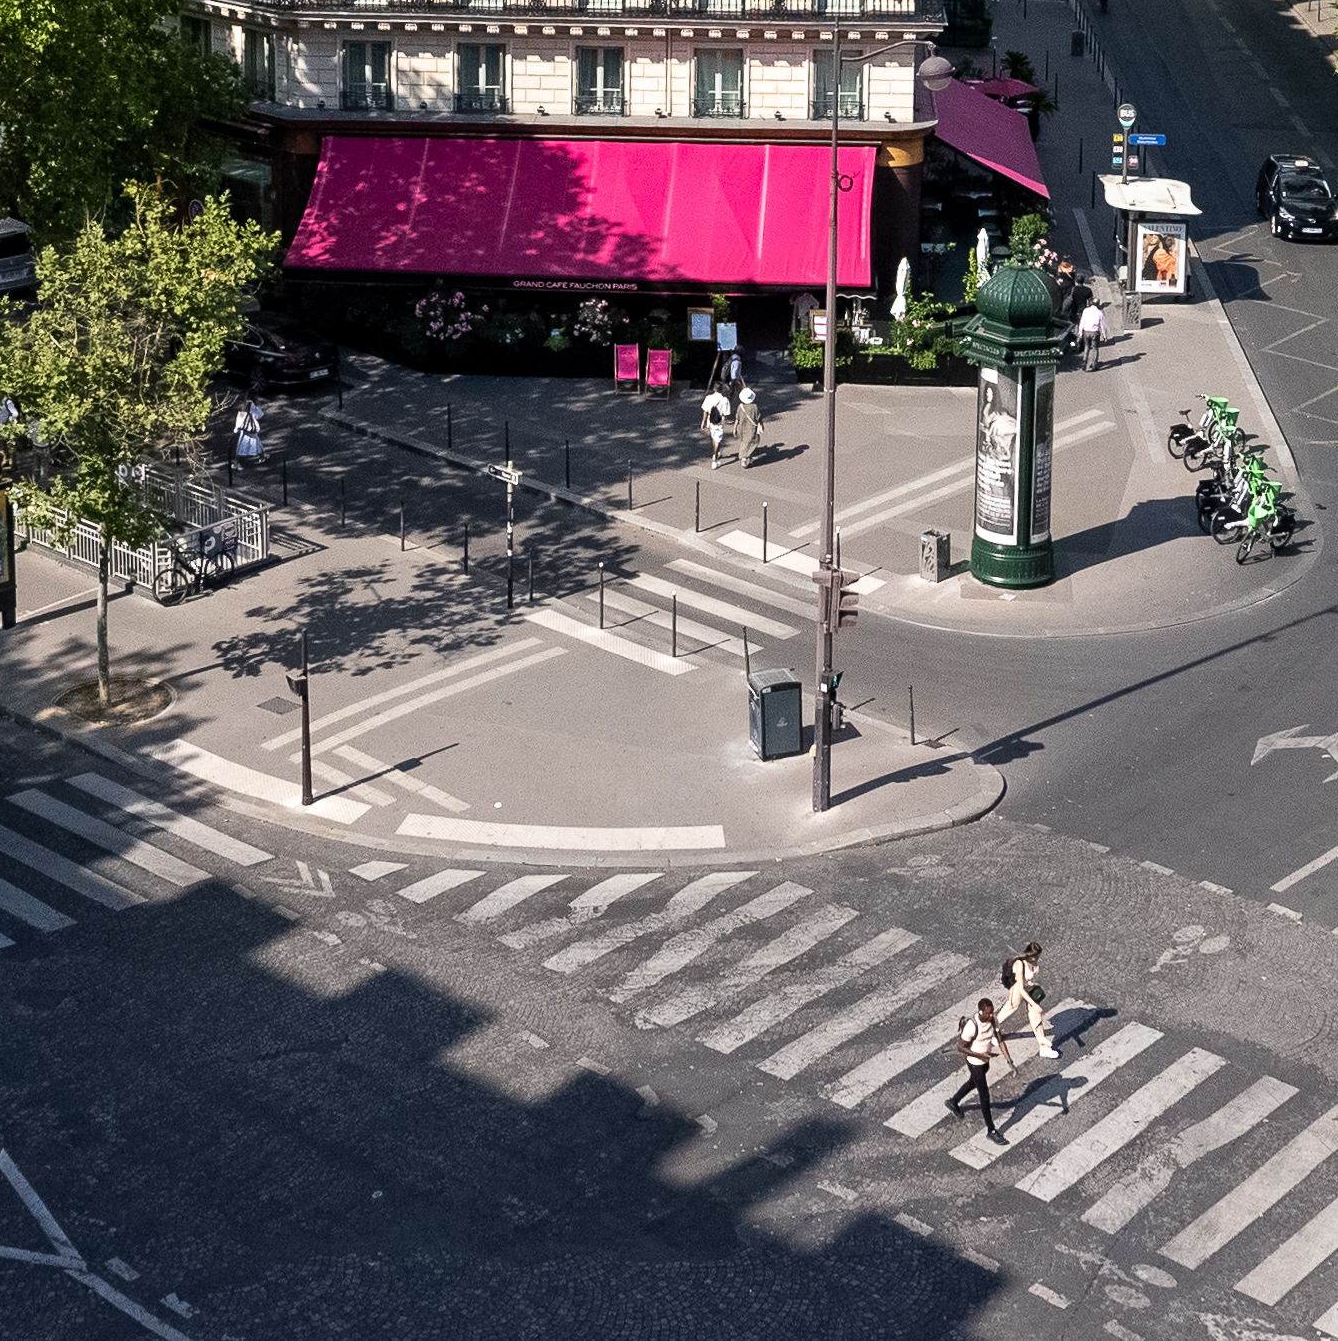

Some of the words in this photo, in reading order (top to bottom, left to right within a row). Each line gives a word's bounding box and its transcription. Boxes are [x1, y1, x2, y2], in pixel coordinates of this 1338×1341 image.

[1120, 109, 1135, 118] BUS
[1143, 225, 1182, 233] VALENTINO
[570, 282, 611, 290] FAUCHON
[1013, 349, 1050, 357] SPECTACLES
